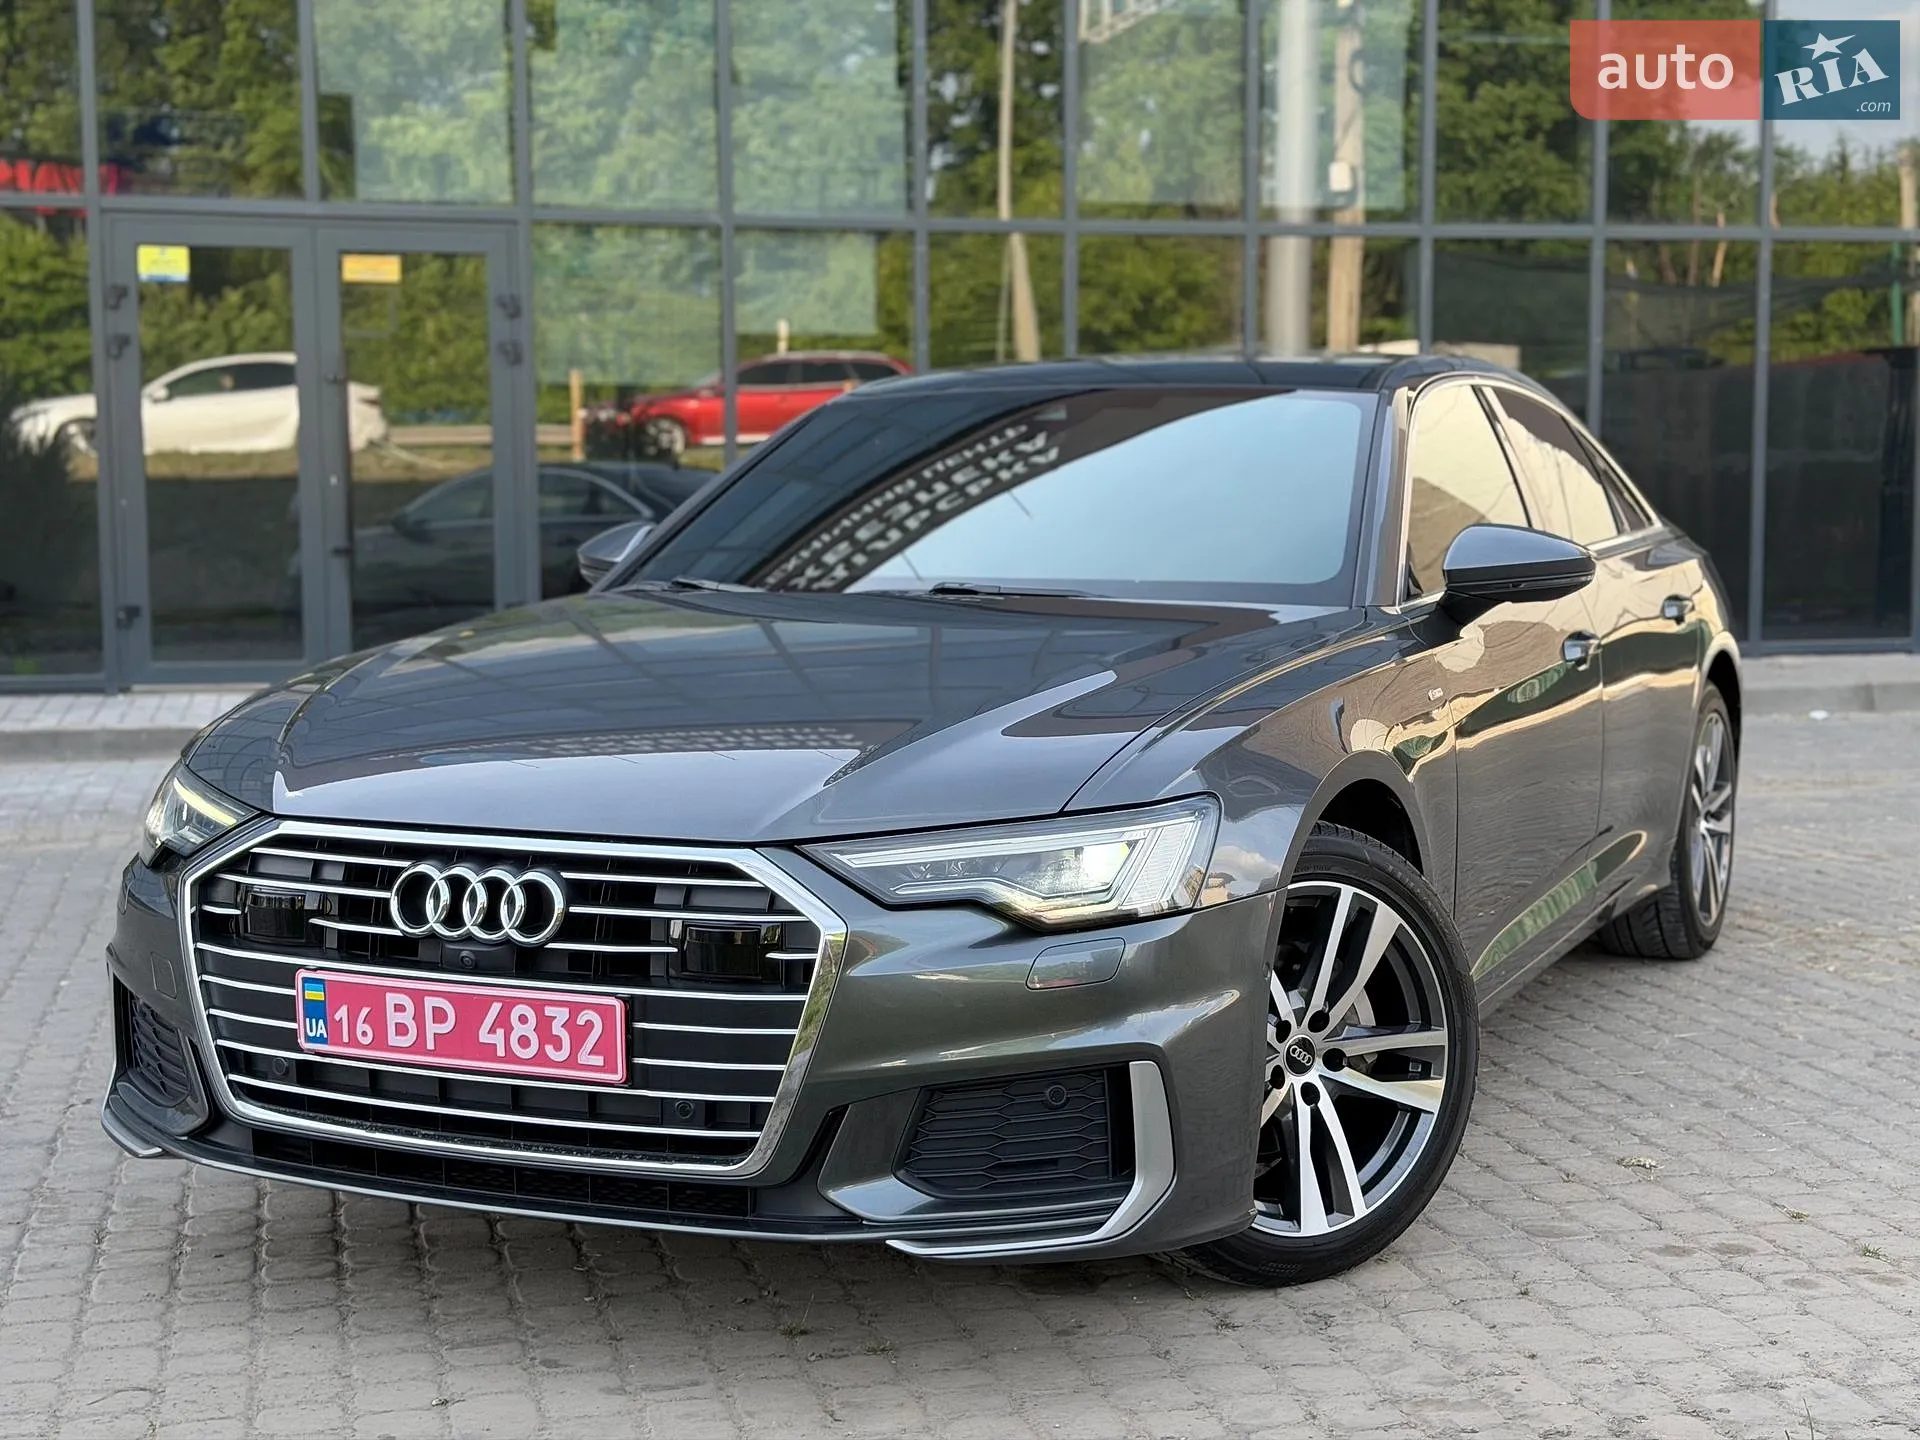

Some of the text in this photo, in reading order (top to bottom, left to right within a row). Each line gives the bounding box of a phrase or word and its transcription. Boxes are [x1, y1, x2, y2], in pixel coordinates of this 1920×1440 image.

[306, 1018, 327, 1038] UA
[334, 992, 604, 1067] 16 BP 4832
